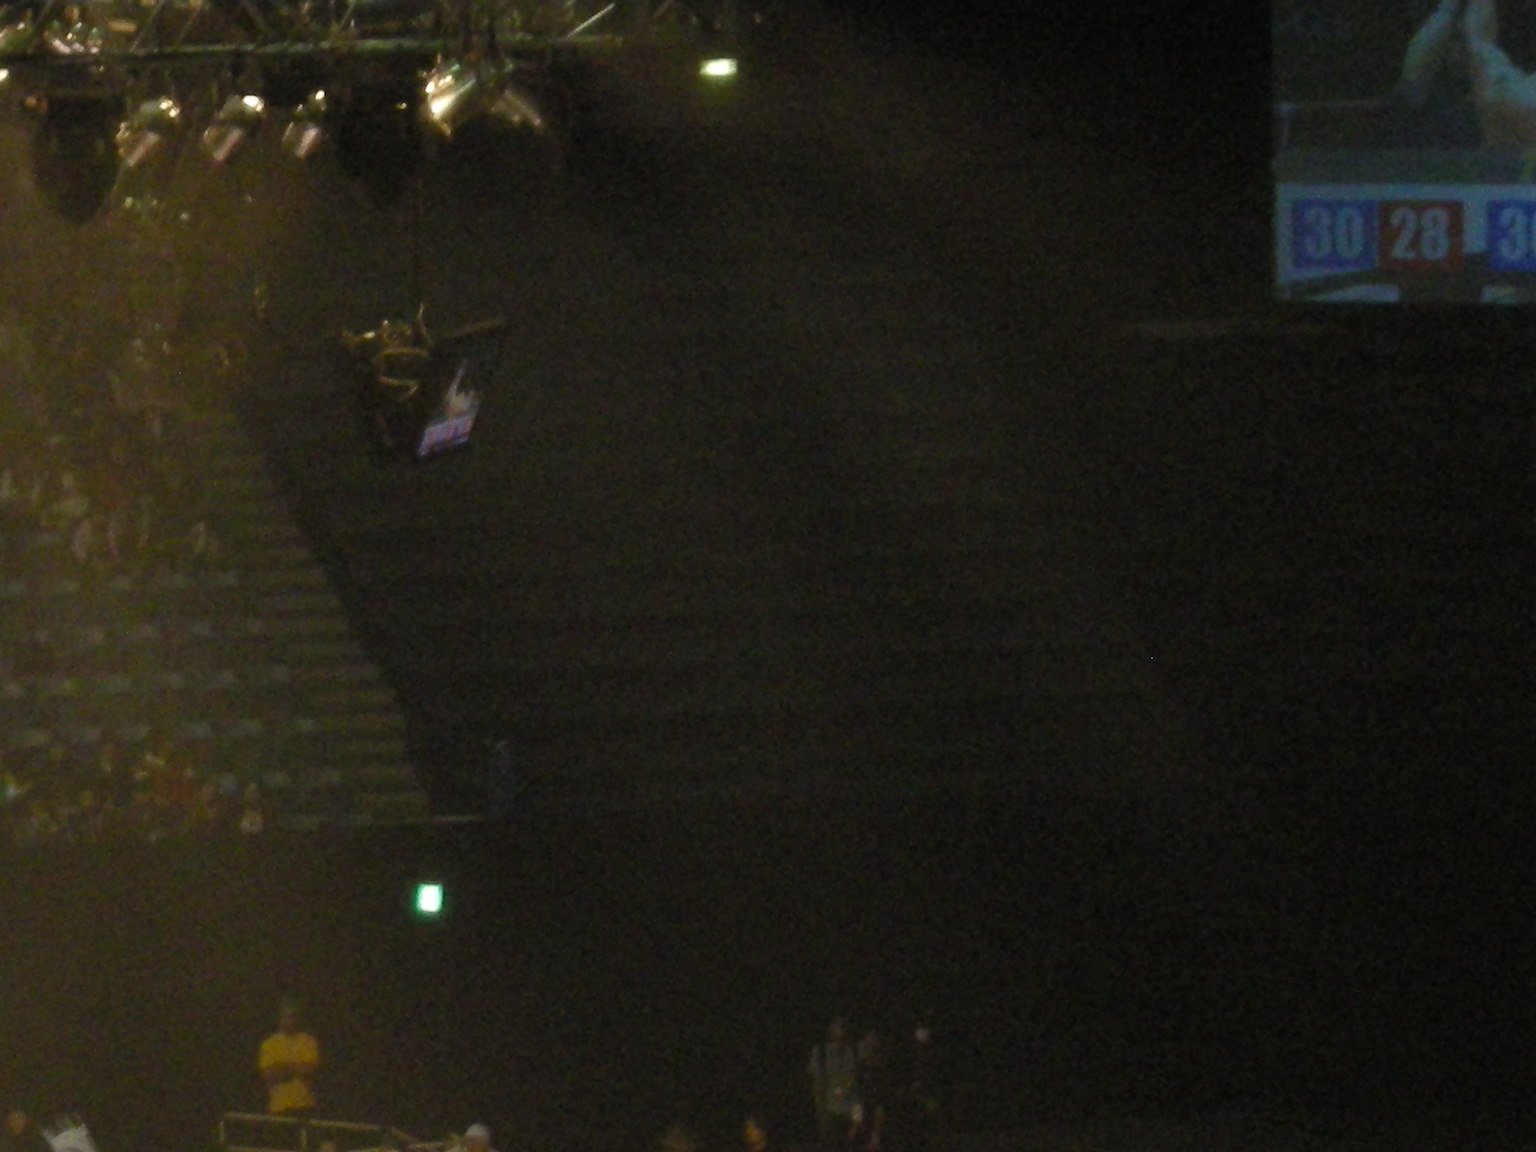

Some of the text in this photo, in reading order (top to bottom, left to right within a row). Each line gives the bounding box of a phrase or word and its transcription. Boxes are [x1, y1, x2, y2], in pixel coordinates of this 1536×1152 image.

[1304, 207, 1536, 260] 30 28 3
